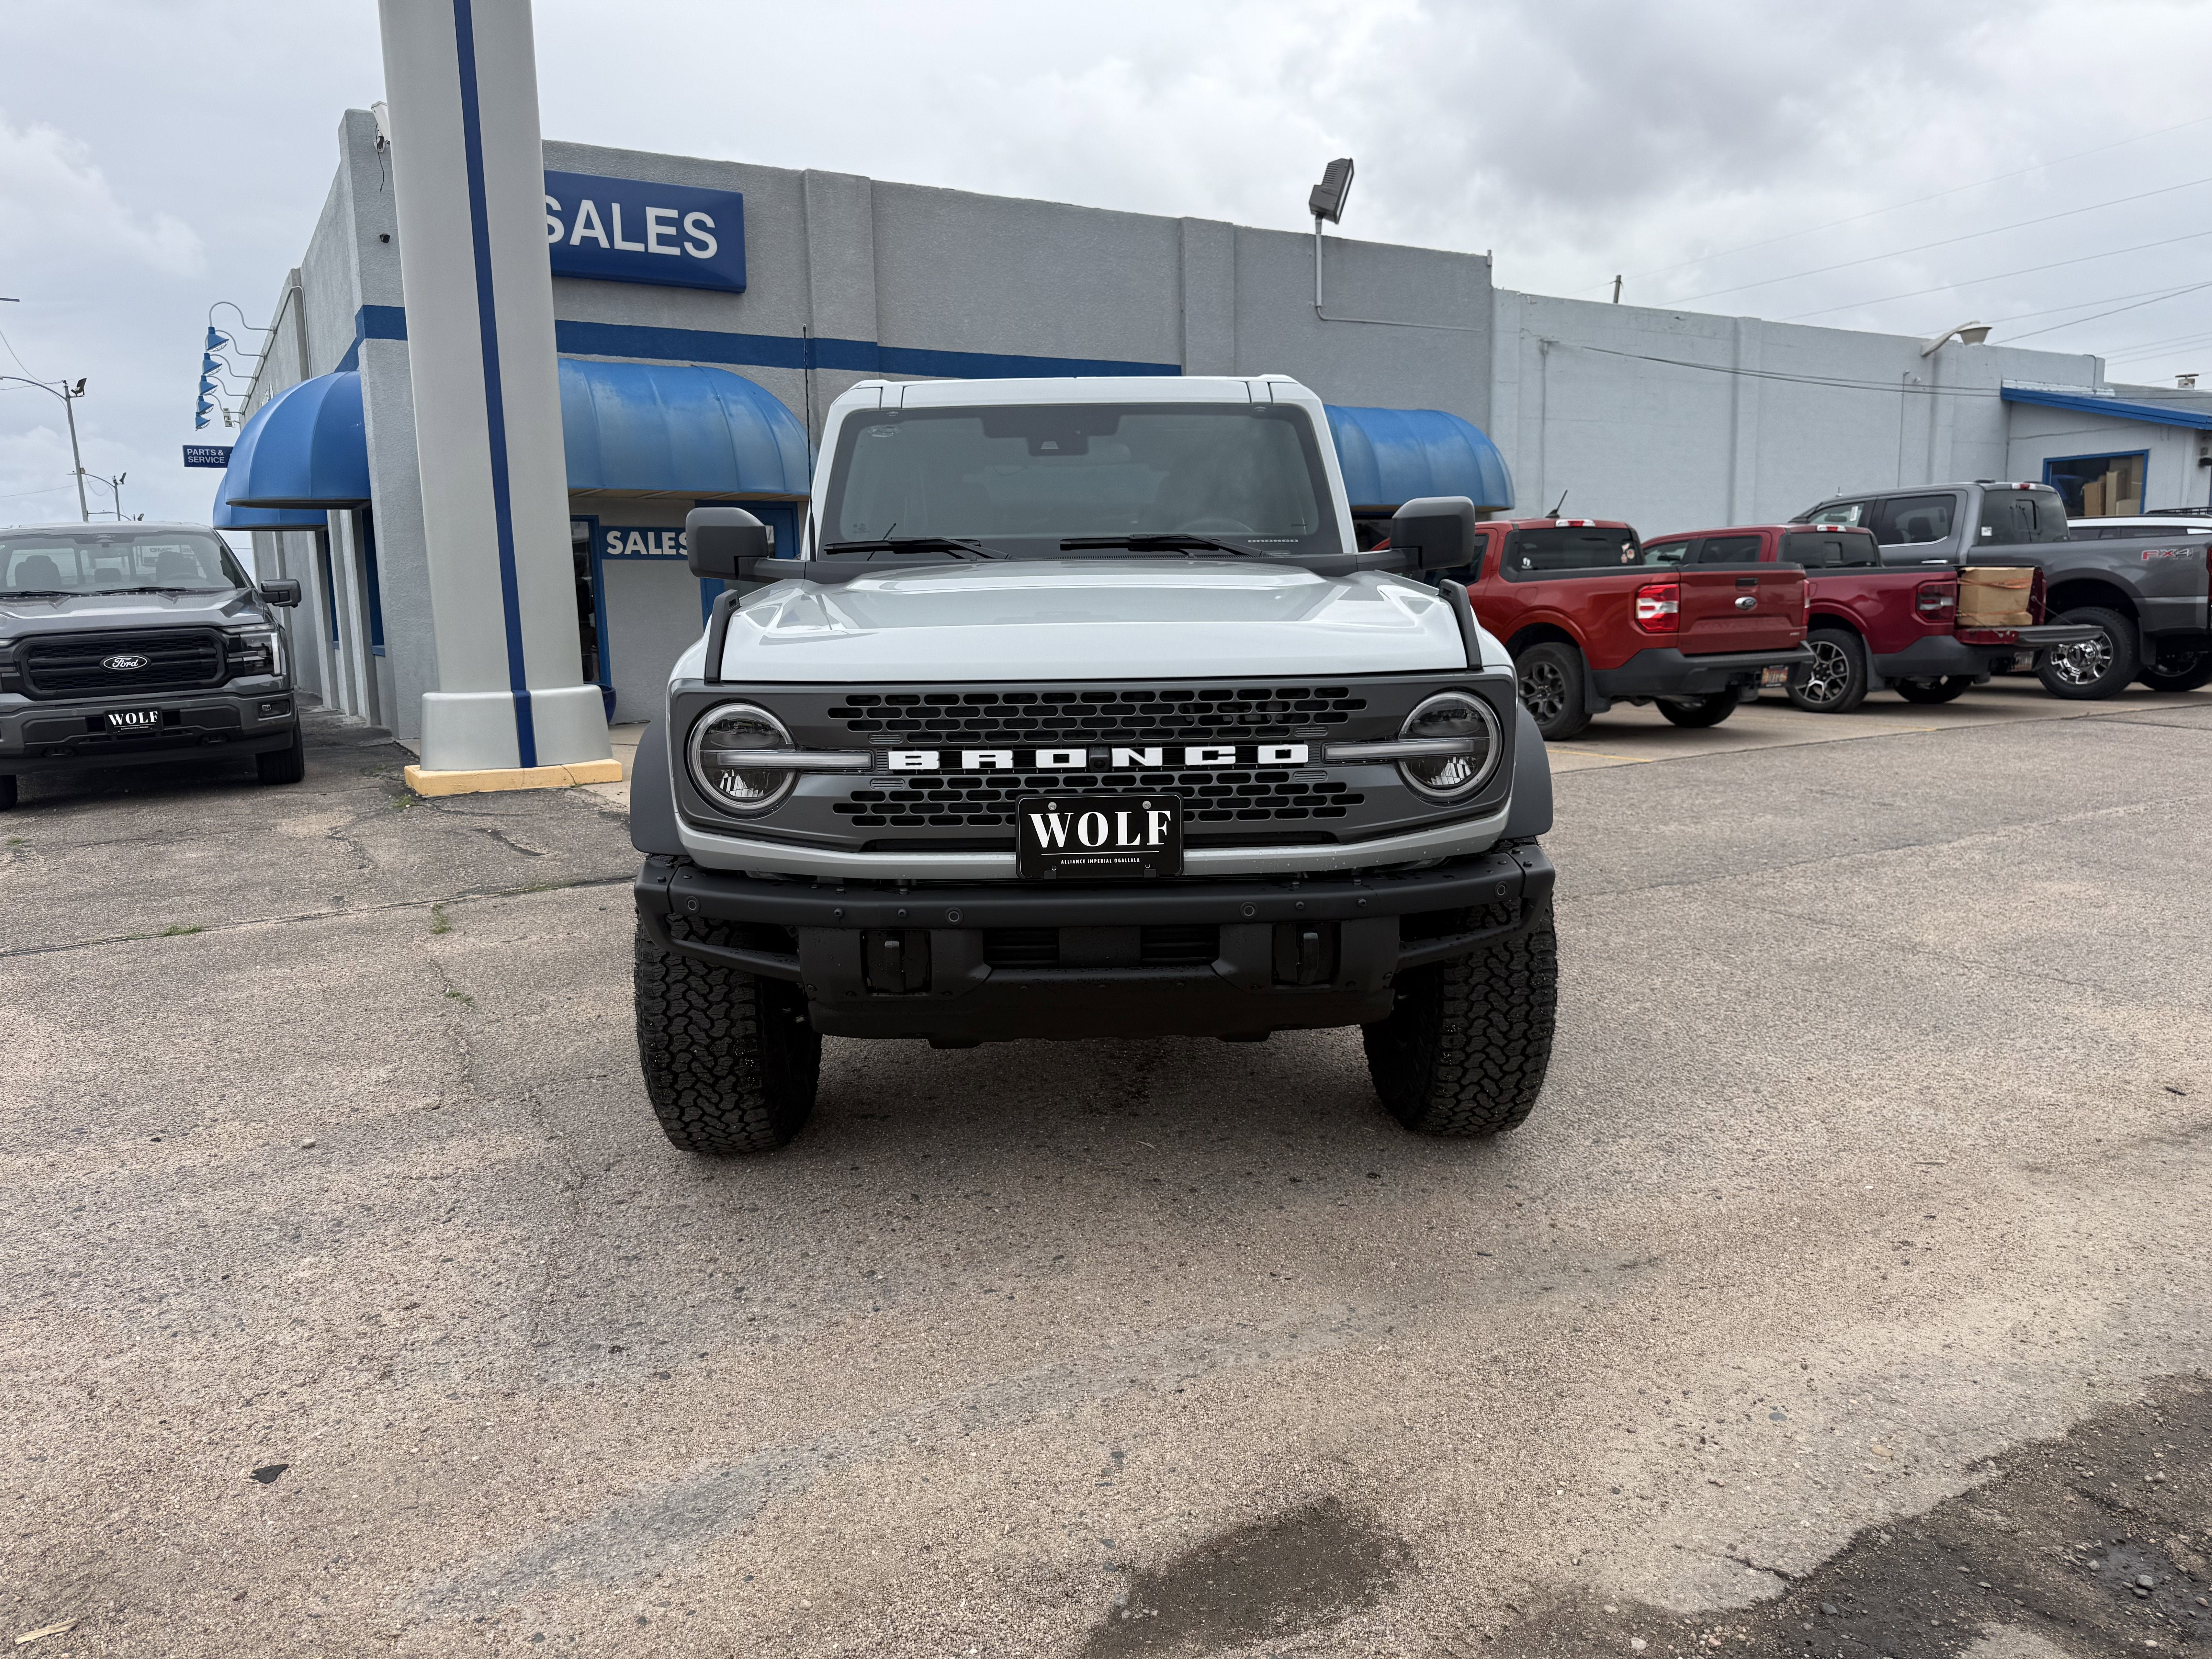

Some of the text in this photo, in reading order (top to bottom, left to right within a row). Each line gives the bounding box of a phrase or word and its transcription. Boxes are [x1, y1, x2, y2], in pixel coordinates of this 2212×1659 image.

[545, 194, 718, 259] SALES
[2141, 548, 2193, 560] FX4
[112, 657, 139, 668] Ford
[108, 711, 158, 726] WOLF
[888, 744, 1309, 770] BRONCO
[1028, 810, 1171, 848] WOLF
